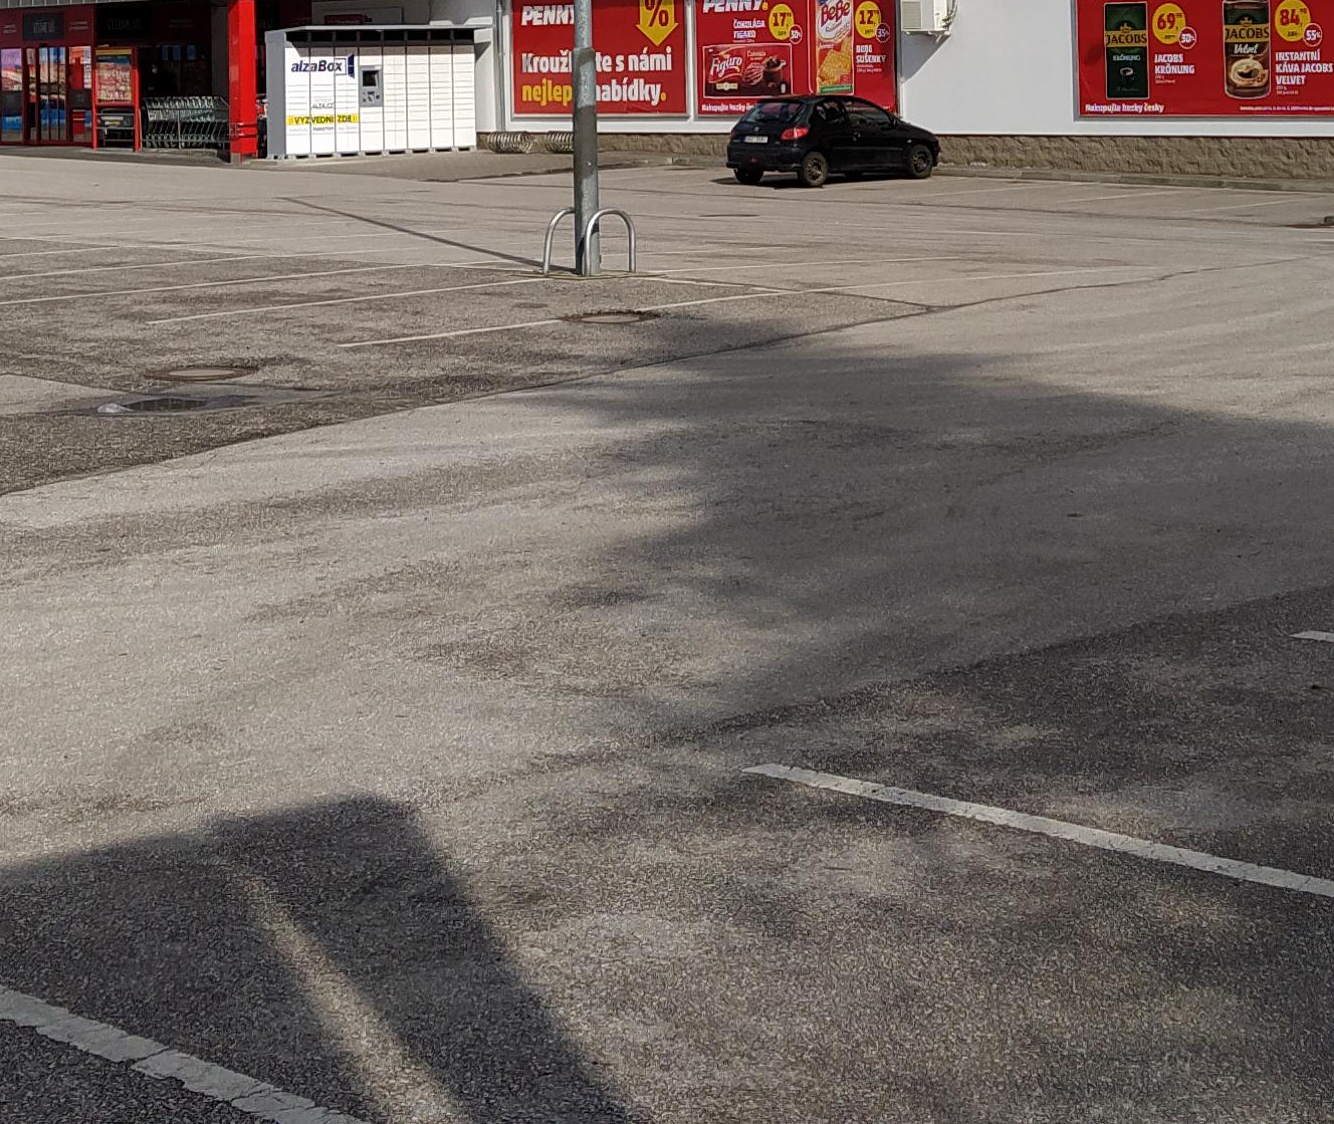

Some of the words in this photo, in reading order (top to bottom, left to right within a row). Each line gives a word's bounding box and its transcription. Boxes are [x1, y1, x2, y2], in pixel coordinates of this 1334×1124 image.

[1105, 33, 1147, 45] JACOBS
[1225, 27, 1270, 39] JACOBS
[616, 55, 625, 72] s
[628, 46, 673, 71] námi
[291, 60, 343, 72] alzaBox
[1275, 75, 1306, 85] VELVET
